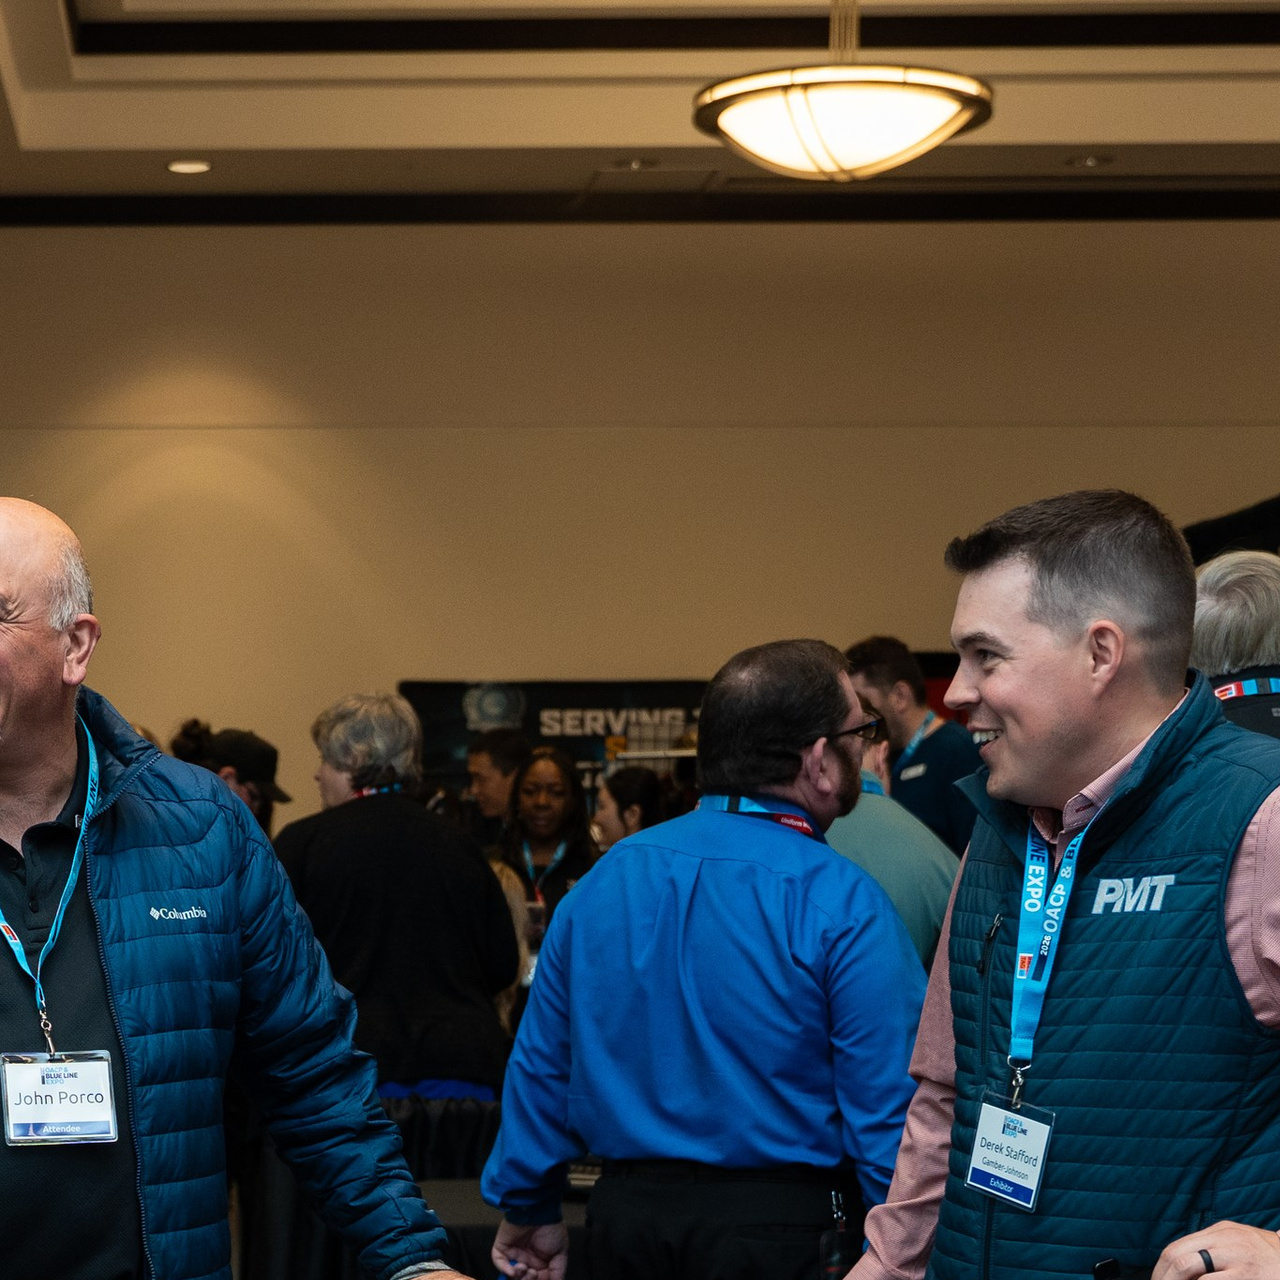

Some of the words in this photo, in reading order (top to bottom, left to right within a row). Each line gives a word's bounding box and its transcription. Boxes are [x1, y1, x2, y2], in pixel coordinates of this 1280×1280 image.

[1060, 865, 1073, 878] &
[1024, 865, 1045, 912] EXPO
[1091, 874, 1175, 914] PMT
[160, 906, 207, 920] Columbia
[1043, 884, 1067, 933] OACP
[1040, 935, 1052, 956] 2026
[15, 1091, 54, 1105] John
[58, 1091, 104, 1104] Porco
[42, 1124, 81, 1133] Attendee
[980, 1137, 1004, 1154] Derek
[1005, 1146, 1038, 1167] Stafford
[982, 1156, 1029, 1180] Gamber-Johnson
[989, 1178, 1014, 1193] Exhibitor
